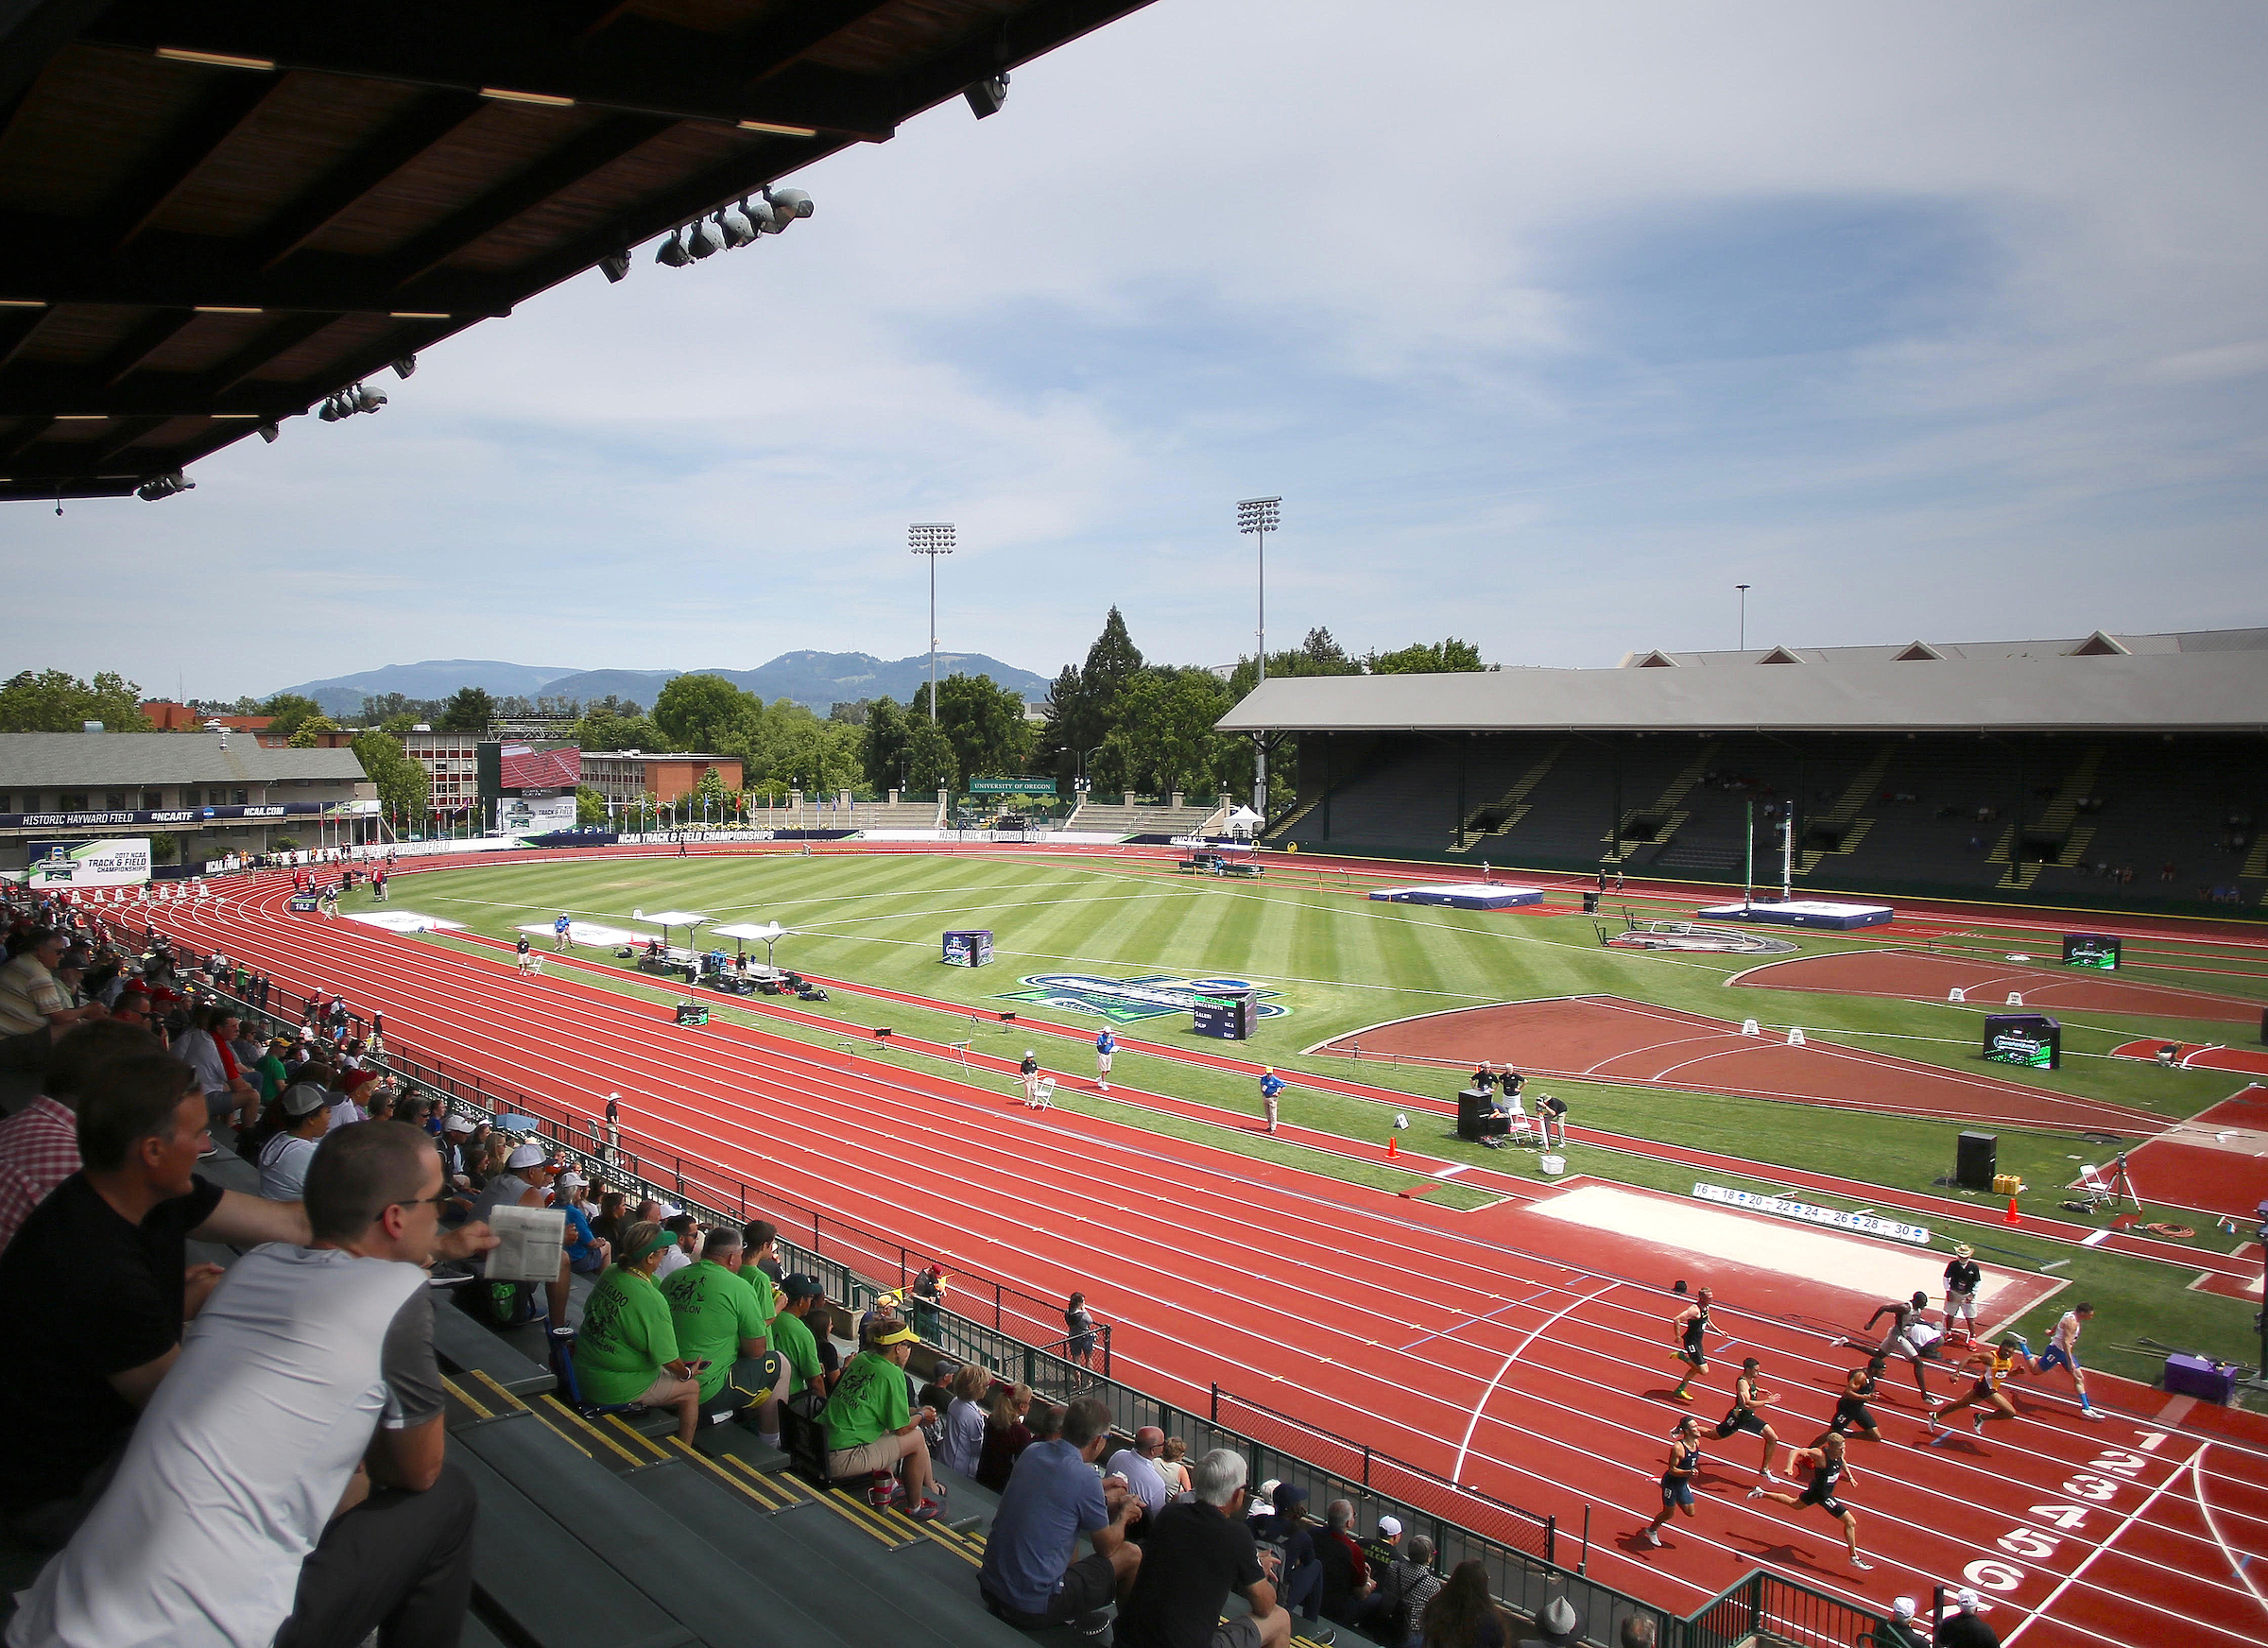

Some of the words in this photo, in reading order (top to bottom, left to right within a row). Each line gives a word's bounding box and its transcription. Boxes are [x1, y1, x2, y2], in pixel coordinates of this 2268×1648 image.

[151, 811, 194, 821] #NCAATF
[243, 806, 284, 816] NCAA.COM
[23, 814, 66, 826] HISTORIC
[67, 813, 108, 825] HAYWARD
[110, 813, 134, 823] FIELD
[617, 833, 640, 844] NCAA
[642, 833, 669, 843] TRACK
[670, 832, 678, 842] &
[679, 832, 701, 842] FIELD
[703, 831, 775, 841] CHAMPIONSHIPS
[938, 831, 979, 840] HISTORIC
[980, 831, 1022, 840] HAYWARD
[1024, 832, 1047, 841] FIELD
[428, 841, 450, 851] FIELD
[1696, 1185, 1709, 1194] 16
[1722, 1190, 1734, 1200] 18
[1749, 1195, 1762, 1206] 20
[1776, 1201, 1790, 1211] 22
[1804, 1207, 1818, 1217] 24
[1833, 1212, 1848, 1223] 26
[1864, 1218, 1878, 1229] 28
[1895, 1225, 1910, 1235] 30
[2134, 1431, 2167, 1451] 1
[2088, 1451, 2146, 1477] 2
[2062, 1474, 2118, 1501] 3
[2027, 1504, 2089, 1529] 4
[1370, 1544, 1390, 1556] TEAM
[1996, 1527, 2061, 1558] 5
[1364, 1549, 1392, 1565] ELGAD
[1962, 1559, 2025, 1591] 6
